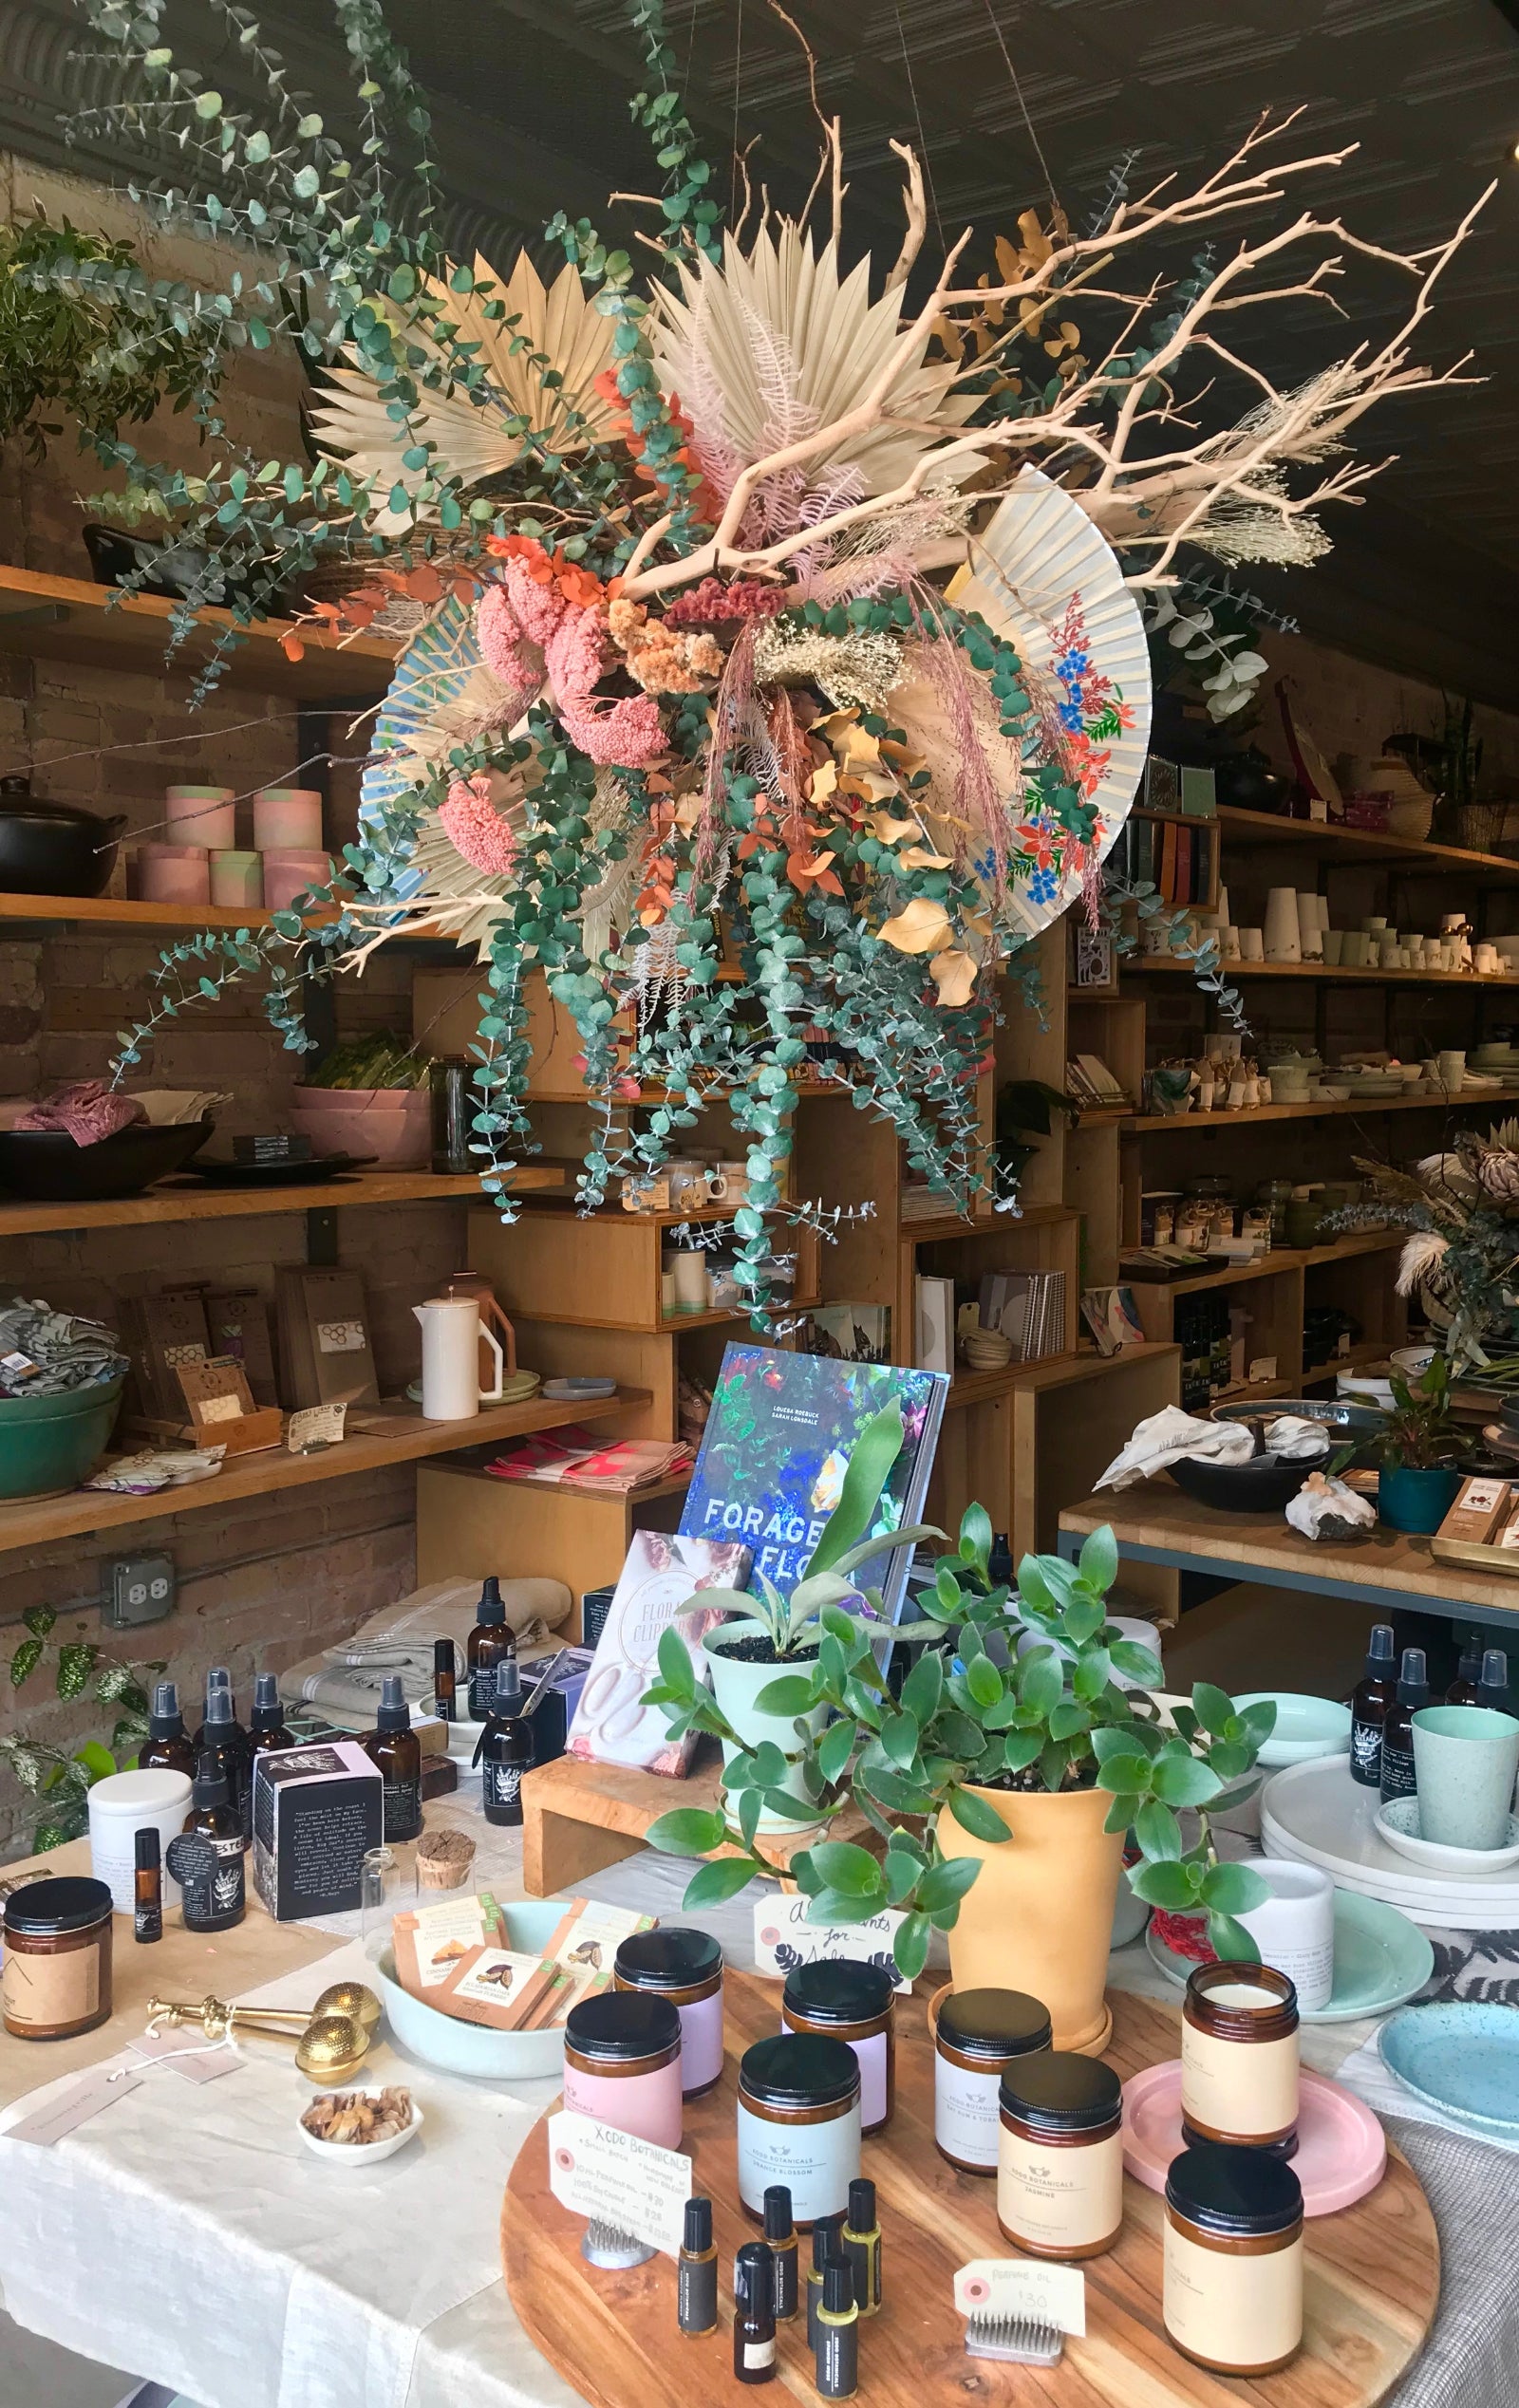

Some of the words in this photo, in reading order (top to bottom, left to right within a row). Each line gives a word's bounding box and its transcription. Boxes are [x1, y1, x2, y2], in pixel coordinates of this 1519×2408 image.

[790, 1416, 818, 1425] LONSDALE
[704, 1499, 826, 1548] FORAGE
[213, 1838, 244, 1856] ESTE
[859, 1915, 890, 1932] ants
[823, 1928, 850, 1947] for
[966, 2103, 1000, 2112] BOTANICA
[770, 2155, 814, 2164] BOTANICALS
[753, 2160, 777, 2173] ORANGE
[1029, 2176, 1074, 2188] BOTANICALS
[1025, 2186, 1055, 2199] JASMINE
[1037, 2273, 1051, 2283] OIL
[1019, 2290, 1048, 2308] $30
